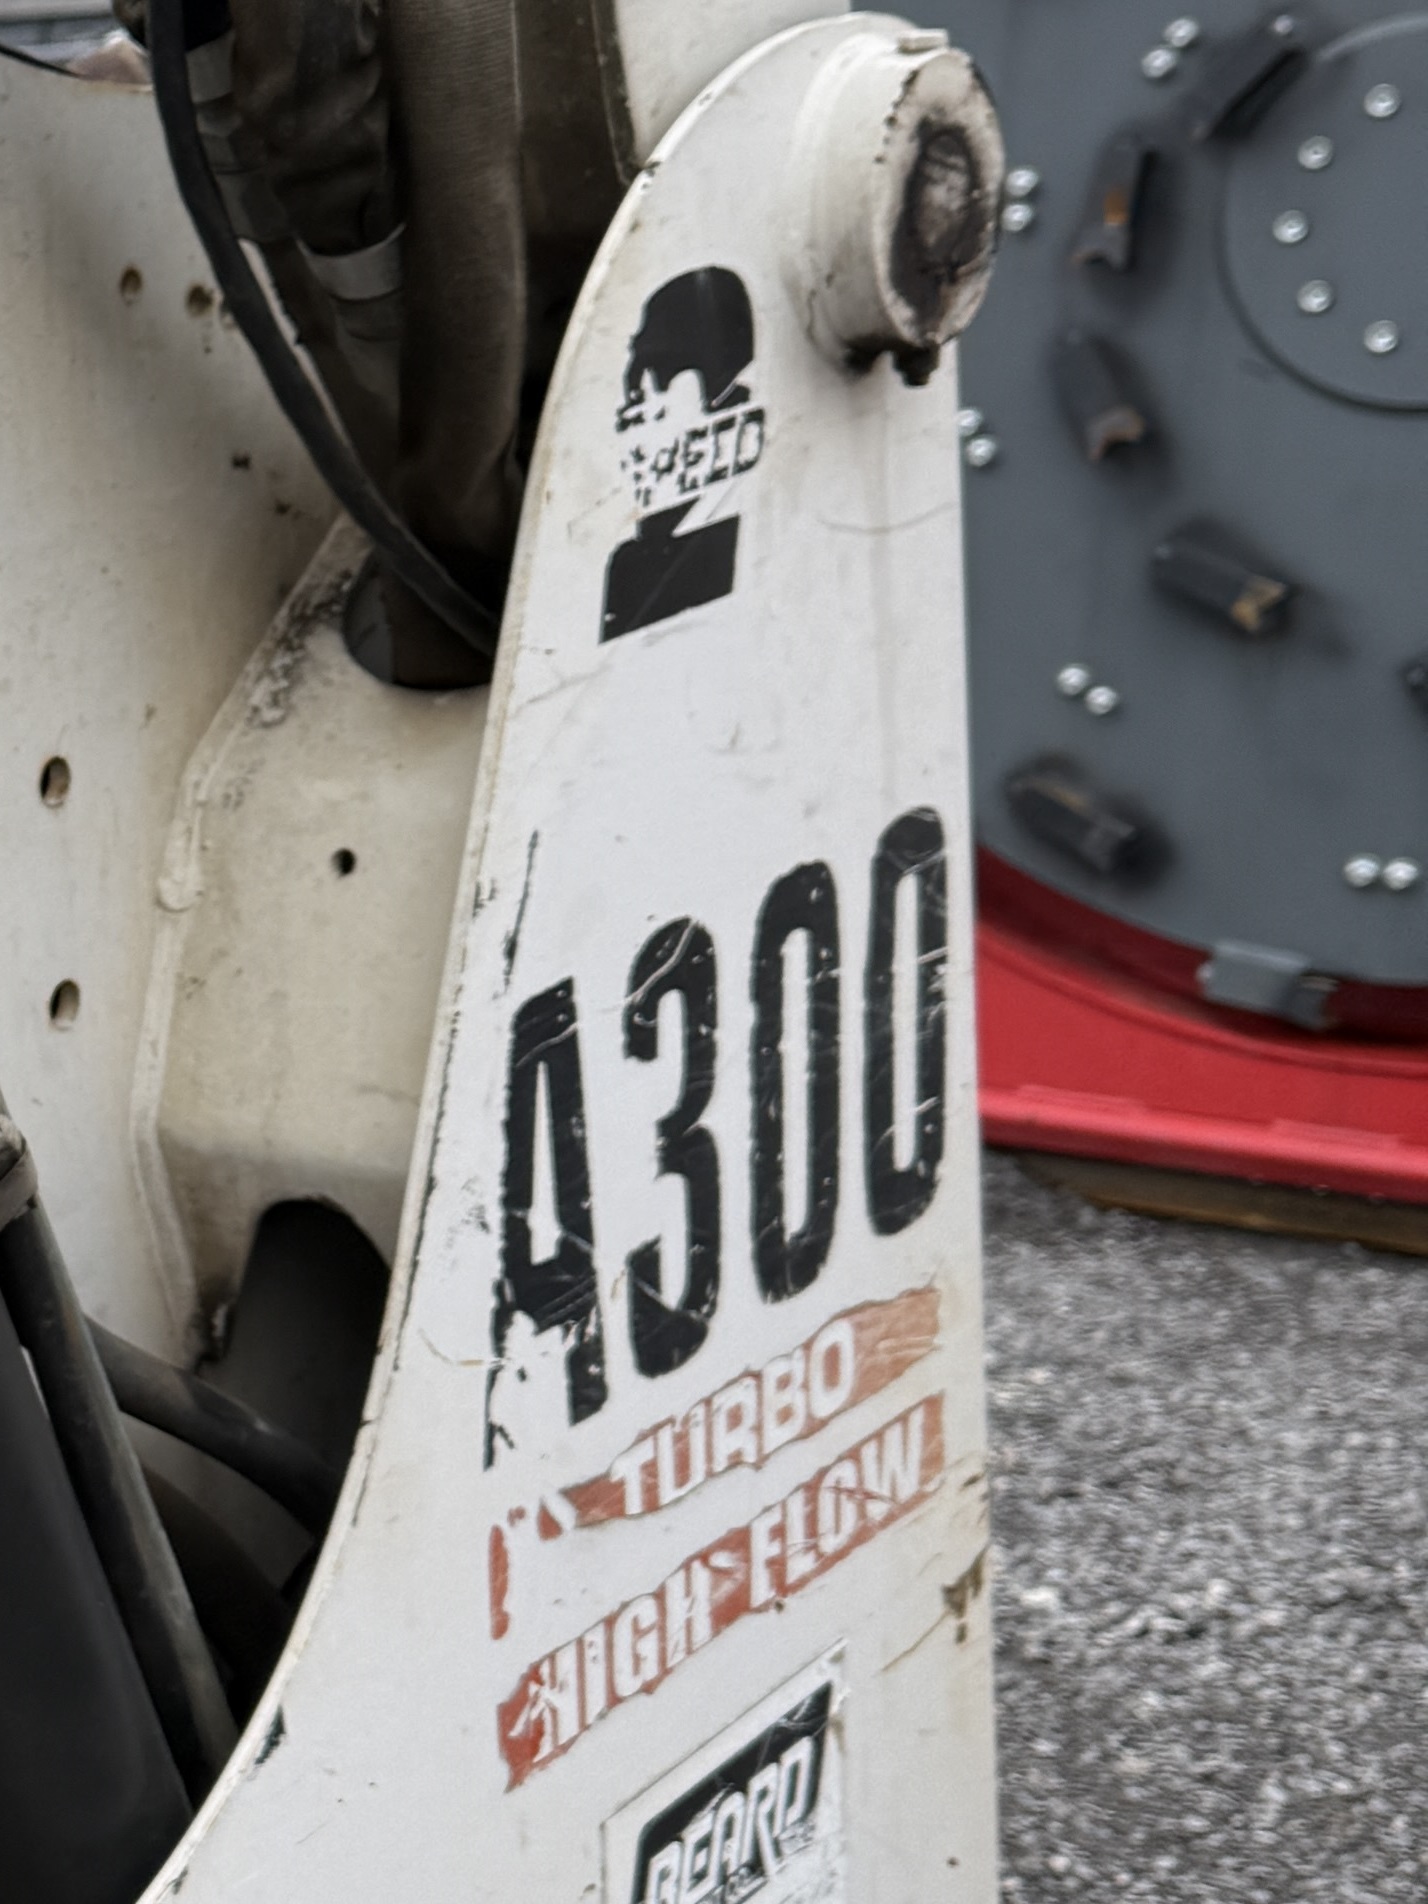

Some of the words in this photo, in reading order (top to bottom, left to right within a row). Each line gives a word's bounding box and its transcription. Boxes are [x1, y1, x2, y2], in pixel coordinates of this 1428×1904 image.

[486, 805, 950, 1472] A300
[532, 1556, 718, 1766] HIGH
[747, 1403, 931, 1612] FLOW
[609, 1317, 858, 1517] TURBO
